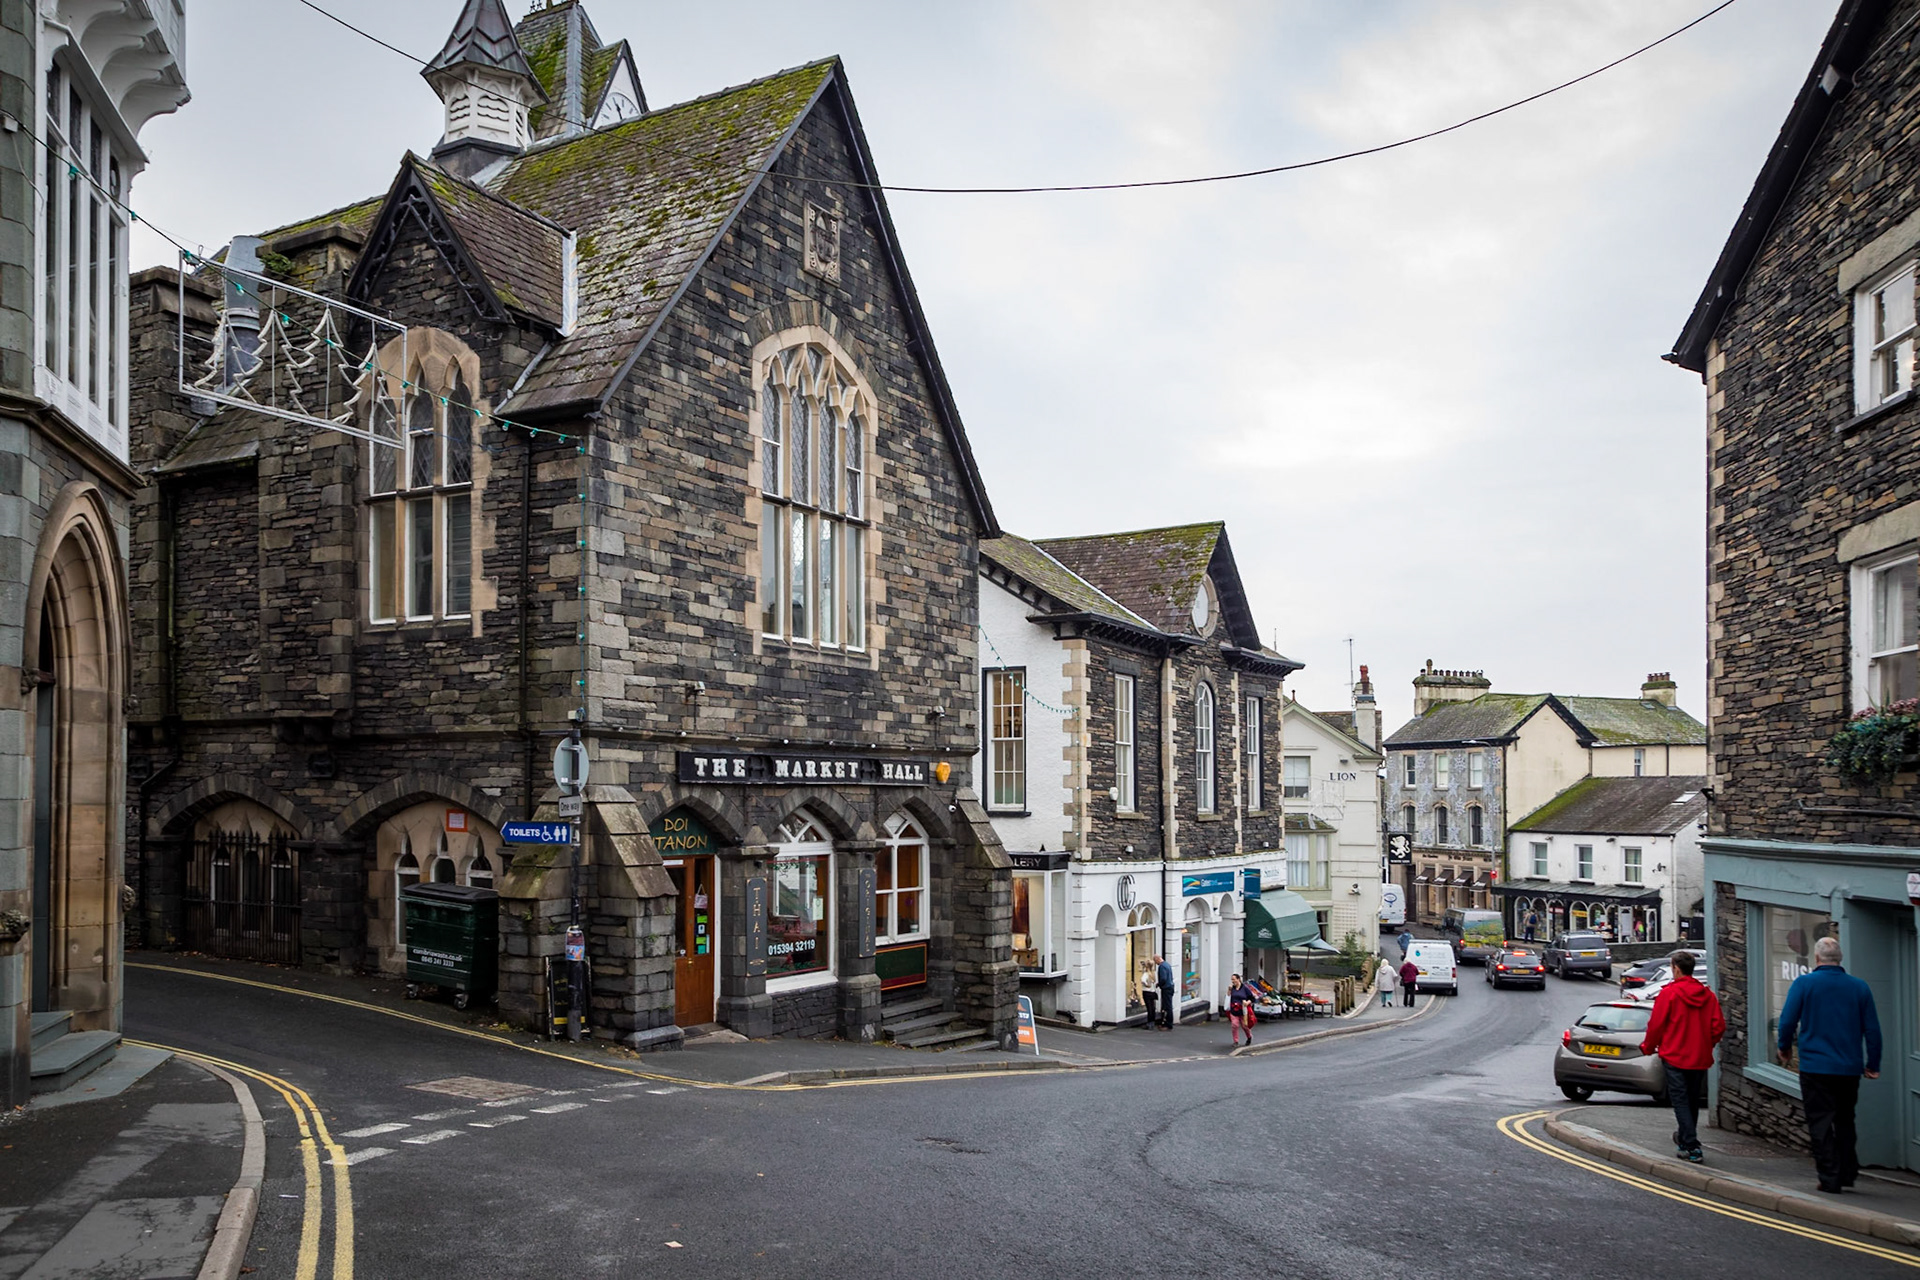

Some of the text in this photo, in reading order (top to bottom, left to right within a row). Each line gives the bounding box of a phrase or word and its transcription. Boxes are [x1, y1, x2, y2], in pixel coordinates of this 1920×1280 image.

[694, 757, 923, 781] THE MARKET HALL
[1329, 772, 1357, 781] LION
[561, 802, 580, 812] One way
[664, 817, 689, 832] DOI
[509, 828, 541, 837] TOILETS
[752, 886, 762, 950] THAI
[767, 939, 816, 956] 015394 32119
